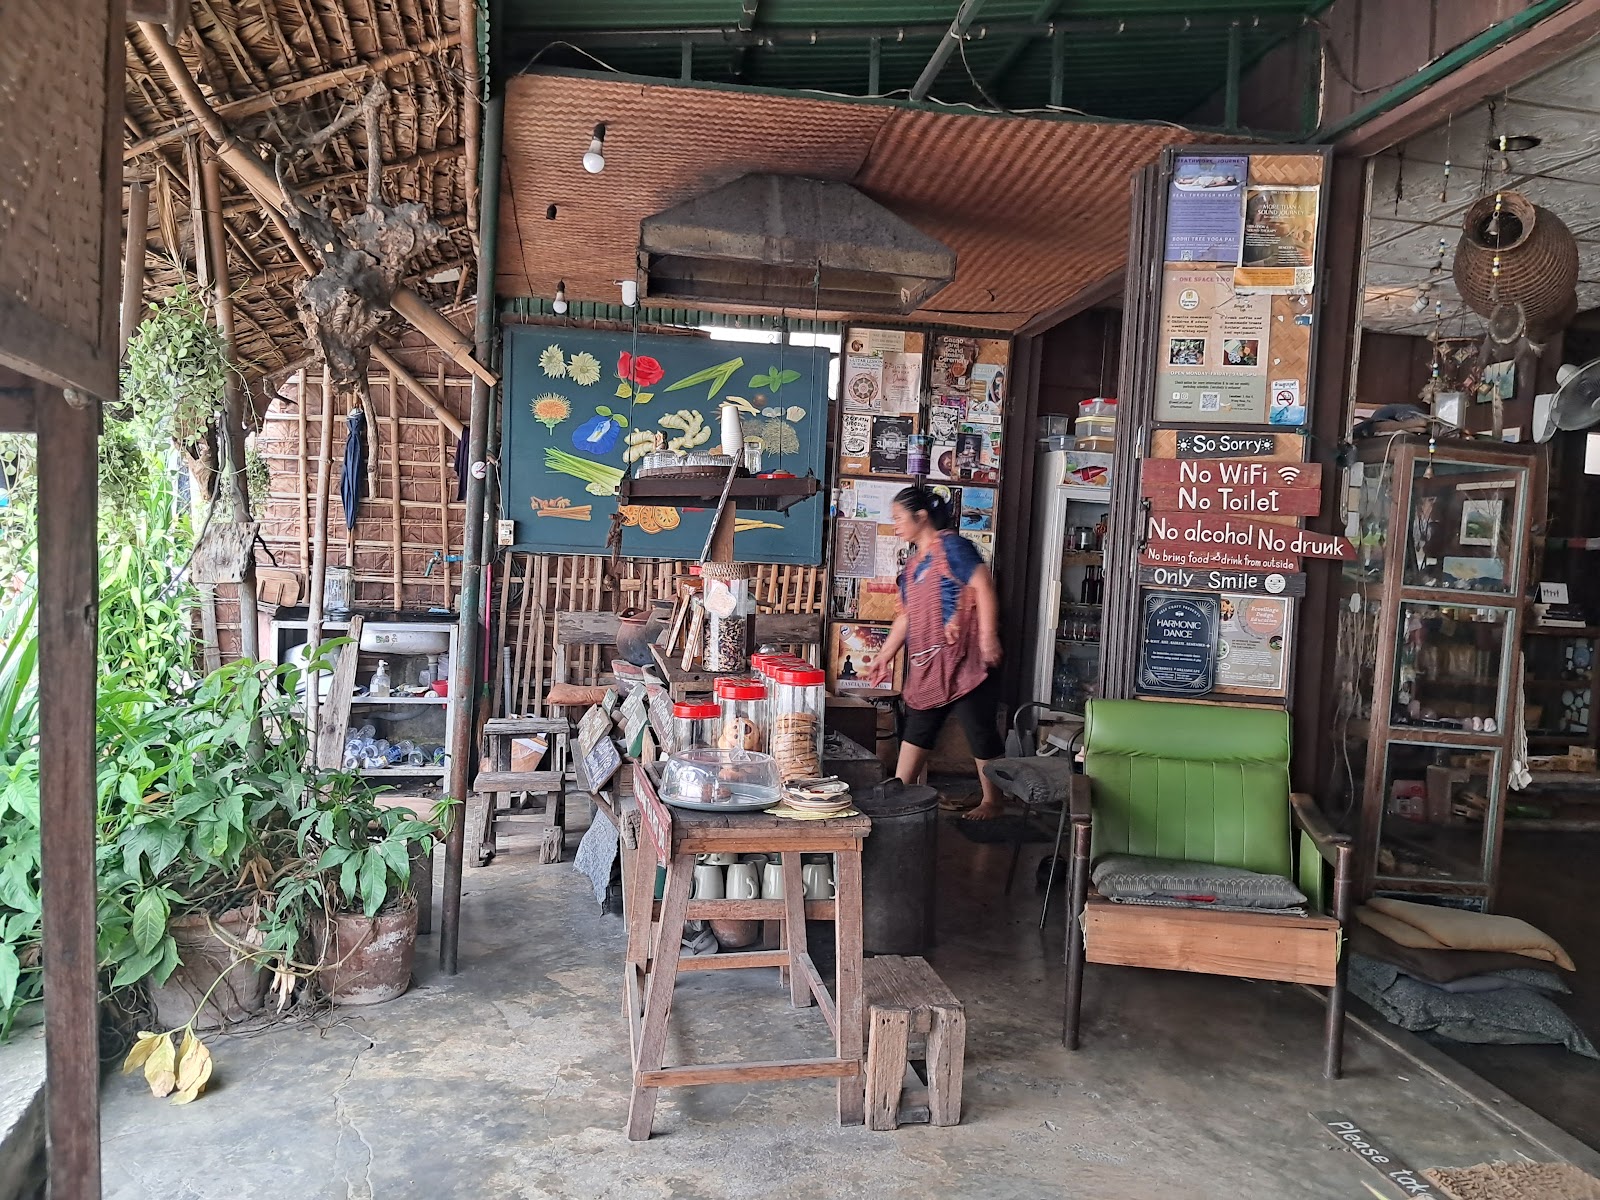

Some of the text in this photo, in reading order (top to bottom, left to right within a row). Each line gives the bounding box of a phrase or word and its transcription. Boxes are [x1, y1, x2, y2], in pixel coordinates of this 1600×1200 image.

[1193, 435, 1261, 454] So Sorry
[1180, 461, 1267, 484] No WiFi
[1178, 486, 1279, 512] No Toilet
[1148, 517, 1344, 557] No alcohol No drunk
[1148, 548, 1161, 561] No
[1162, 549, 1186, 566] bring
[1188, 551, 1209, 564] food
[1221, 553, 1243, 565] drink
[1244, 555, 1261, 568] from
[1262, 556, 1294, 570] outside
[1154, 567, 1258, 590] Only Smile
[1156, 619, 1202, 630] HARMONIC
[1163, 628, 1193, 639] DANCE
[1327, 1121, 1390, 1163] Please
